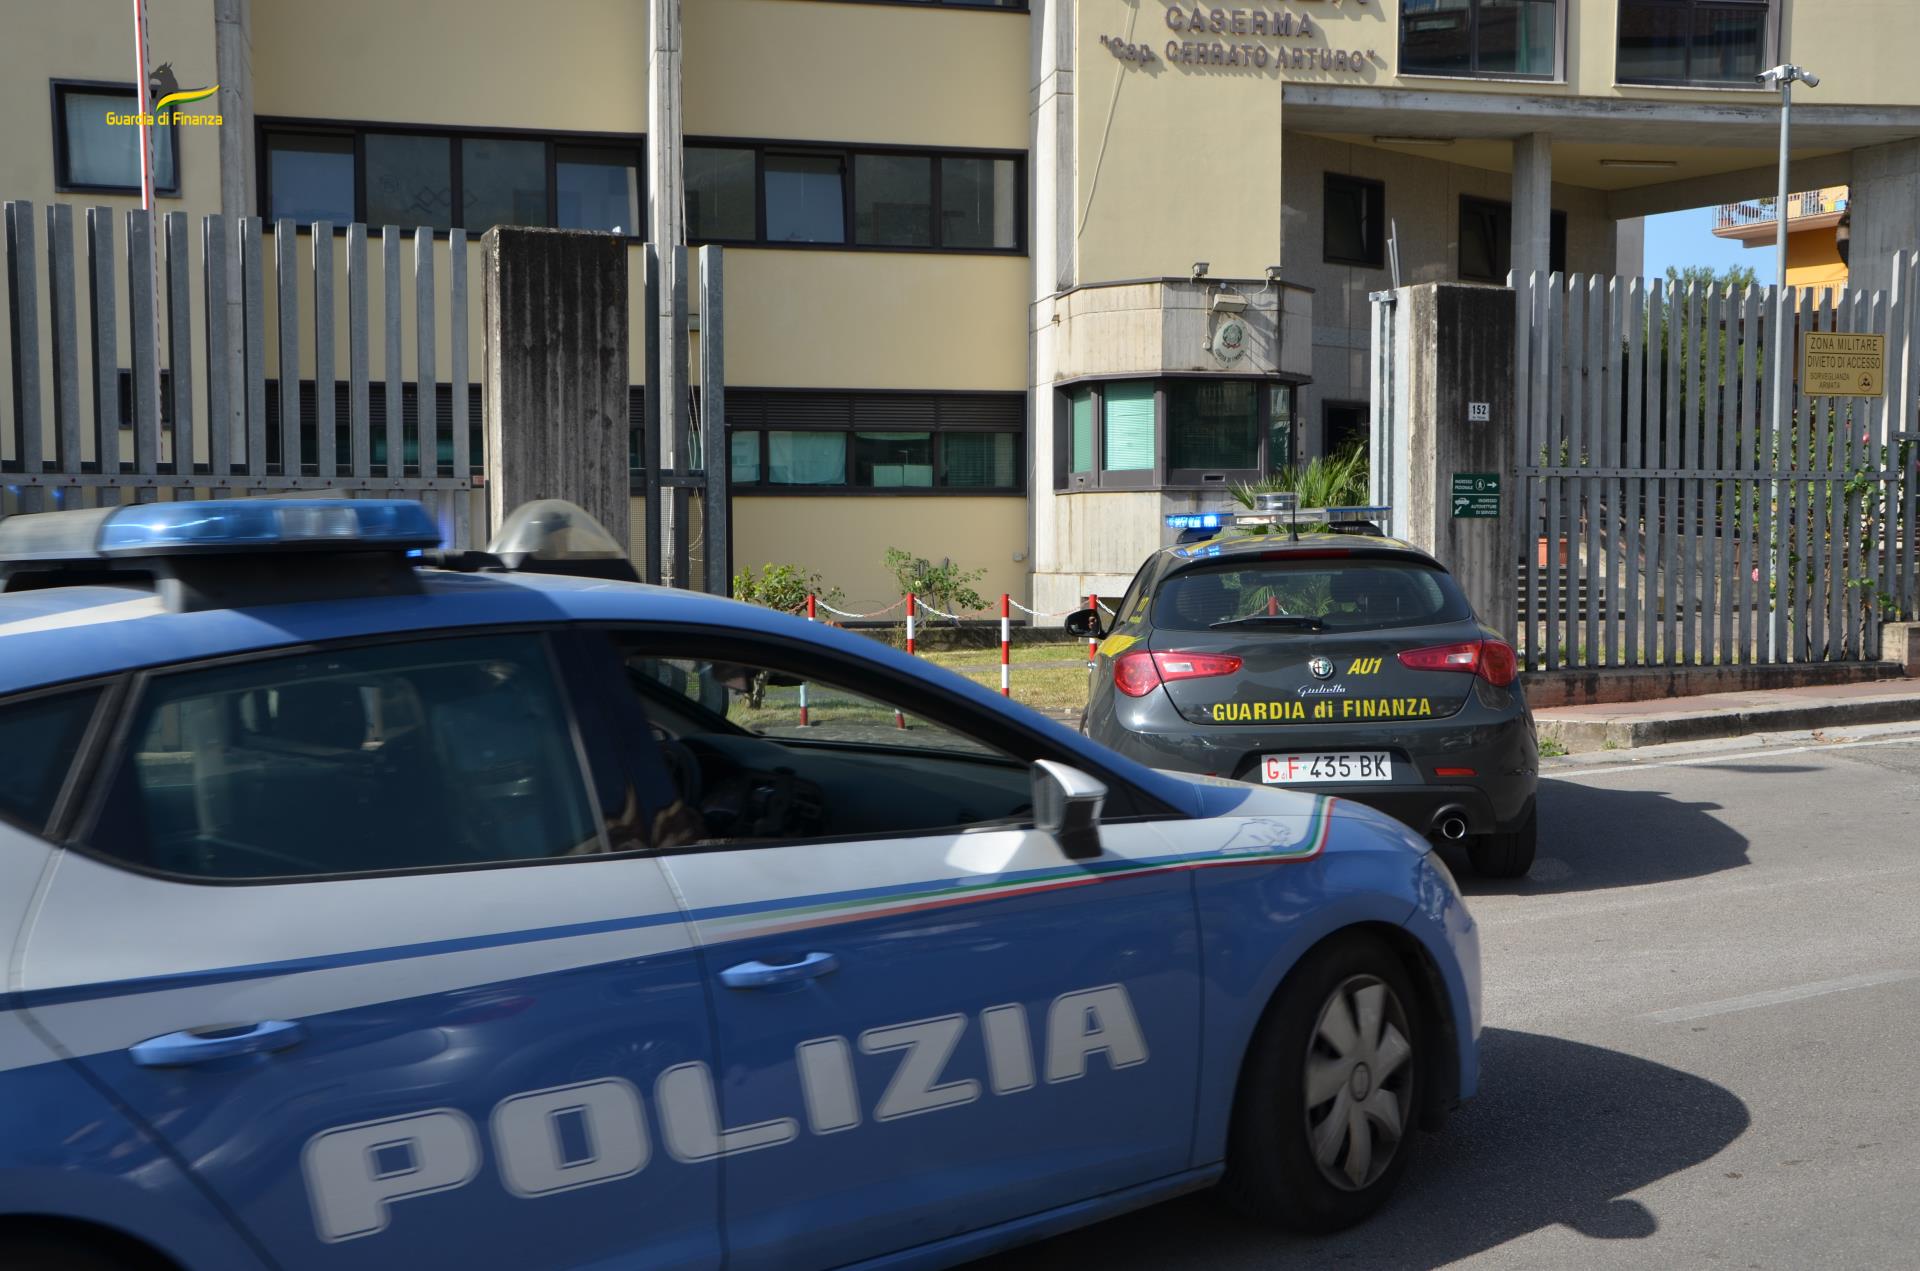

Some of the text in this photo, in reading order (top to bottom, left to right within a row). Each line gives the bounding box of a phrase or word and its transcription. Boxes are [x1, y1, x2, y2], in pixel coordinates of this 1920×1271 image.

[1165, 6, 1313, 38] CASERMA
[1165, 40, 1268, 68] CERRATO
[1811, 337, 1878, 351] ZONA MILITARE
[1808, 355, 1881, 369] DIVIETO DI ACCESSO
[1472, 404, 1487, 415] 152
[1347, 657, 1383, 675] AU1
[1212, 697, 1431, 721] GUARDIA di FINANZA
[1310, 756, 1351, 778] 435
[1360, 755, 1387, 777] BK
[301, 983, 1148, 1244] POLIZIA
